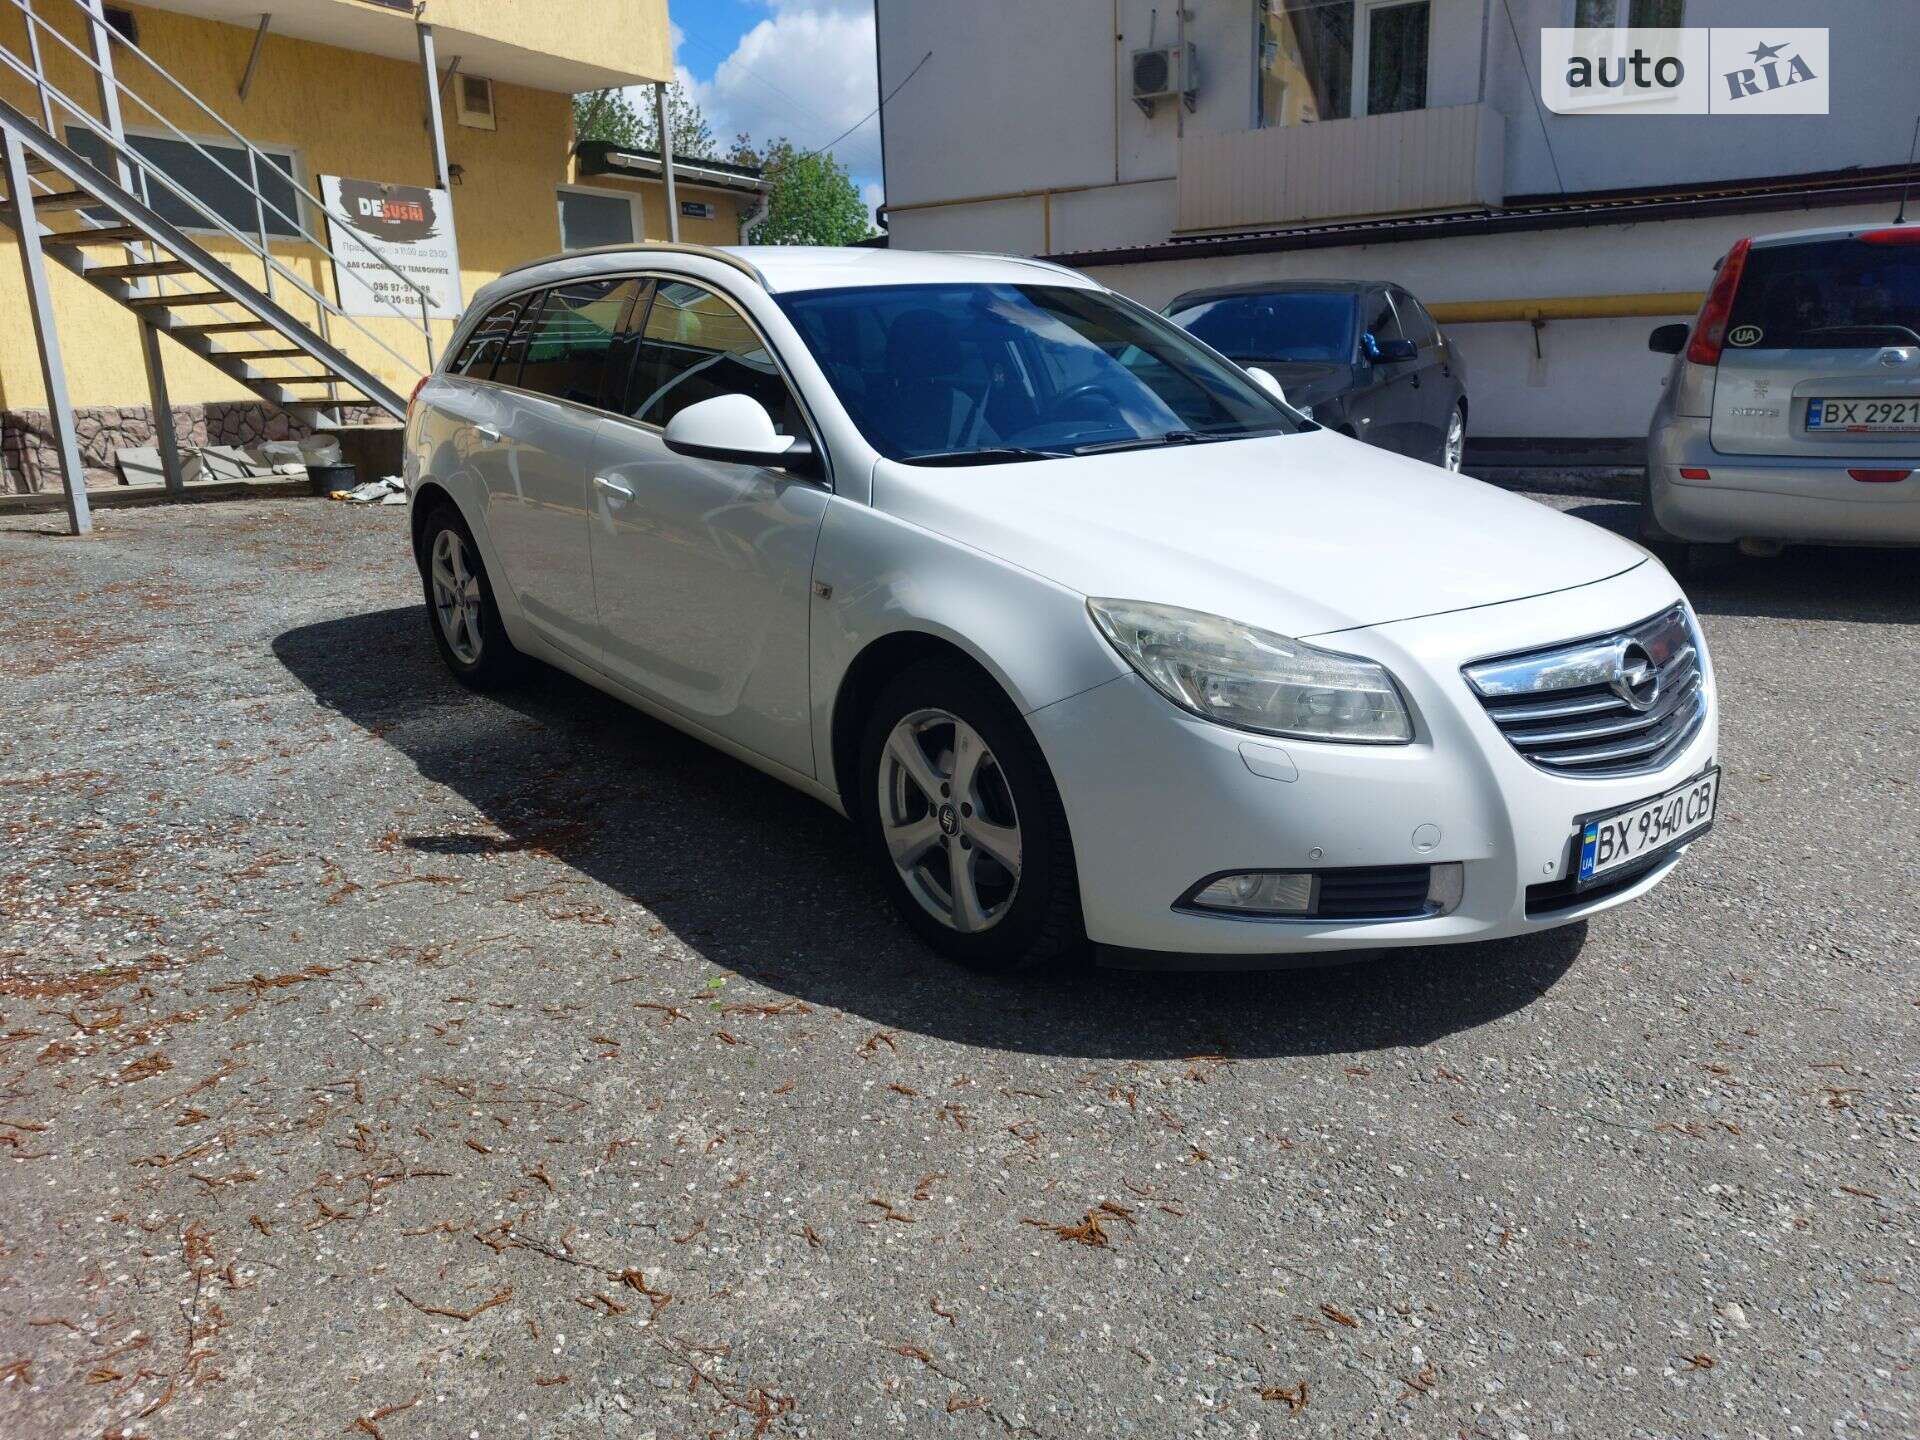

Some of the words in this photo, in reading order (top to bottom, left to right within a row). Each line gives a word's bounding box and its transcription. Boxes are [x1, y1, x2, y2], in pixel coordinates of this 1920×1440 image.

[1735, 329, 1757, 343] UA
[1824, 403, 1858, 423] BX
[1865, 403, 1920, 423] 2921
[1582, 858, 1593, 871] UA
[1598, 817, 1633, 866] BX
[1637, 796, 1684, 850] 9340
[1686, 782, 1712, 825] CB
